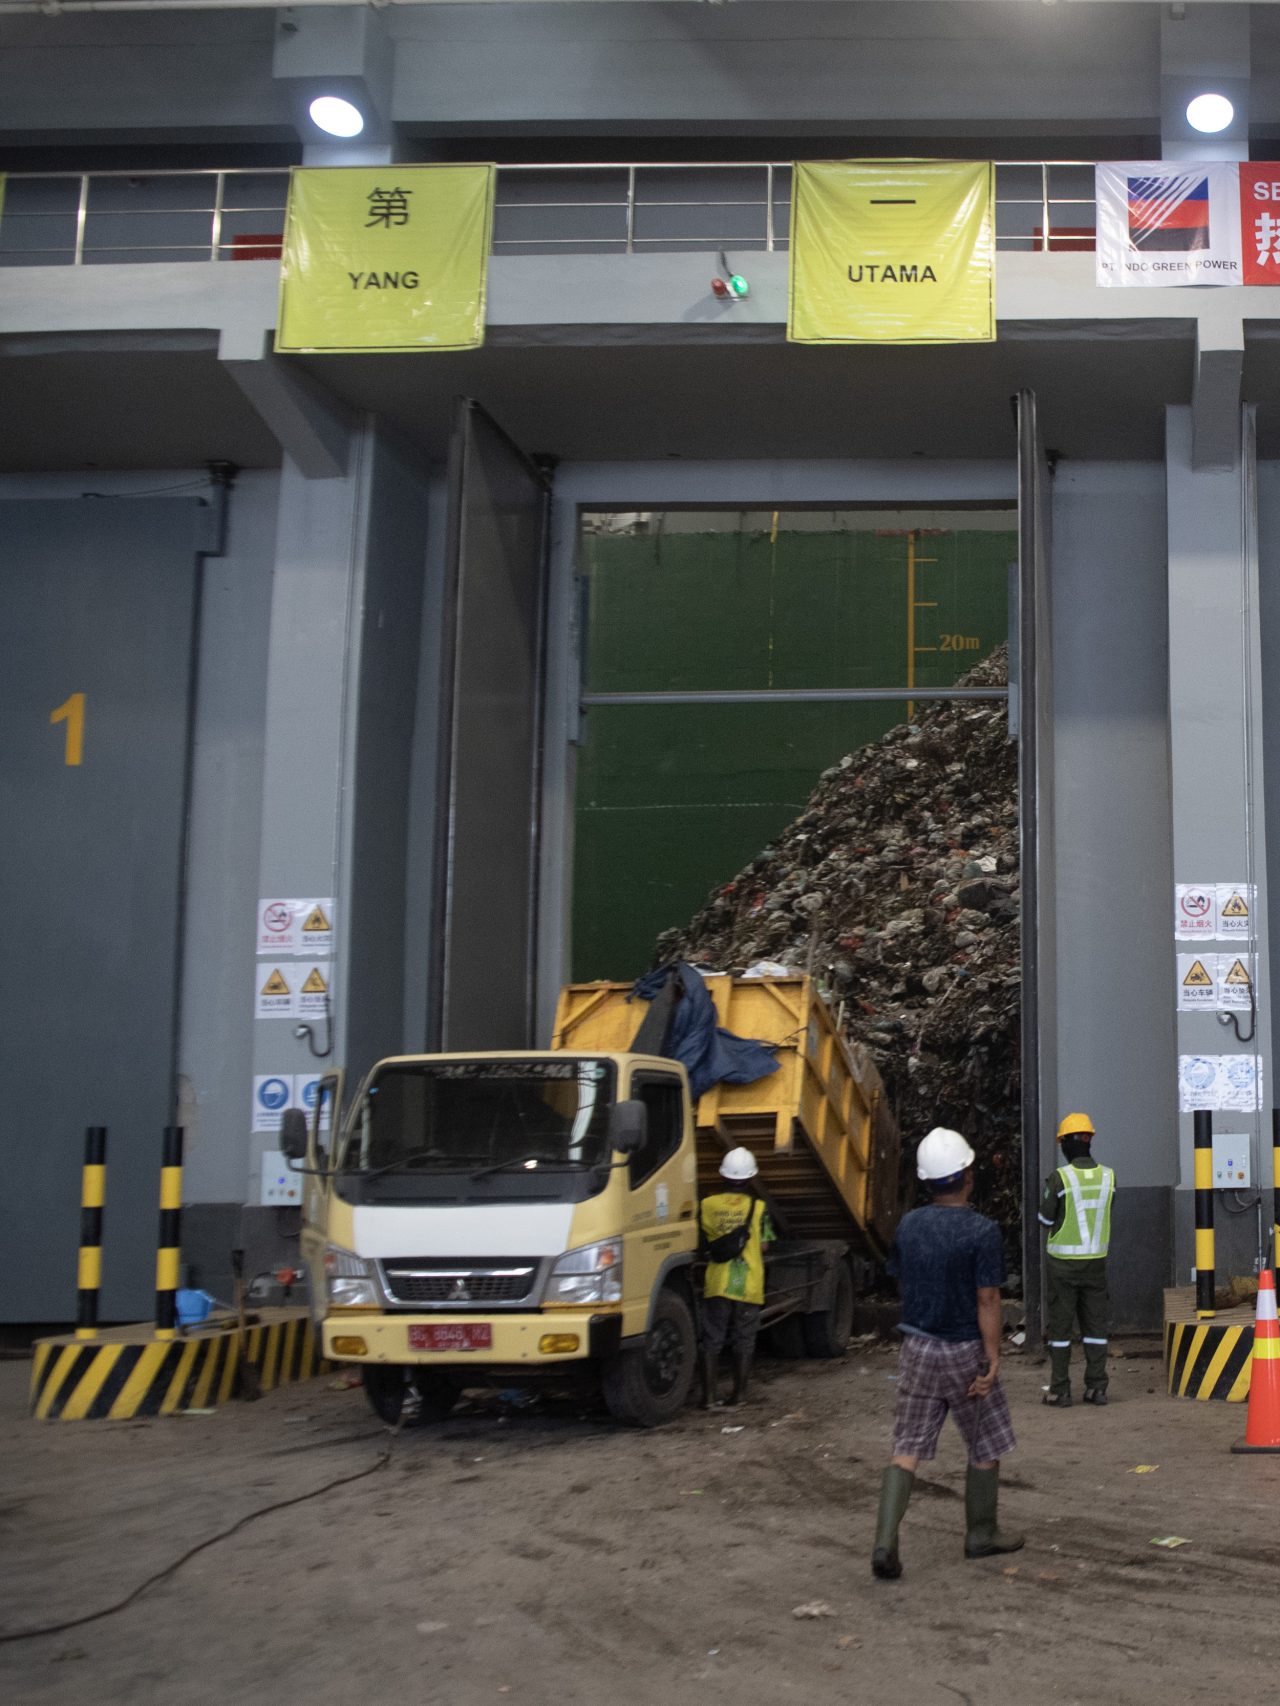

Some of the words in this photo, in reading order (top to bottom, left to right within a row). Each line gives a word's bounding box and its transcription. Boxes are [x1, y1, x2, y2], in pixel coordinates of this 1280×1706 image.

[364, 186, 413, 229] 第
[847, 264, 938, 284] UTAMA
[1123, 262, 1149, 272] NDO
[1152, 262, 1191, 272] GREEN
[1195, 259, 1238, 270] POWER
[348, 270, 420, 290] YANG
[938, 633, 981, 652] 20m
[49, 691, 87, 767] 1
